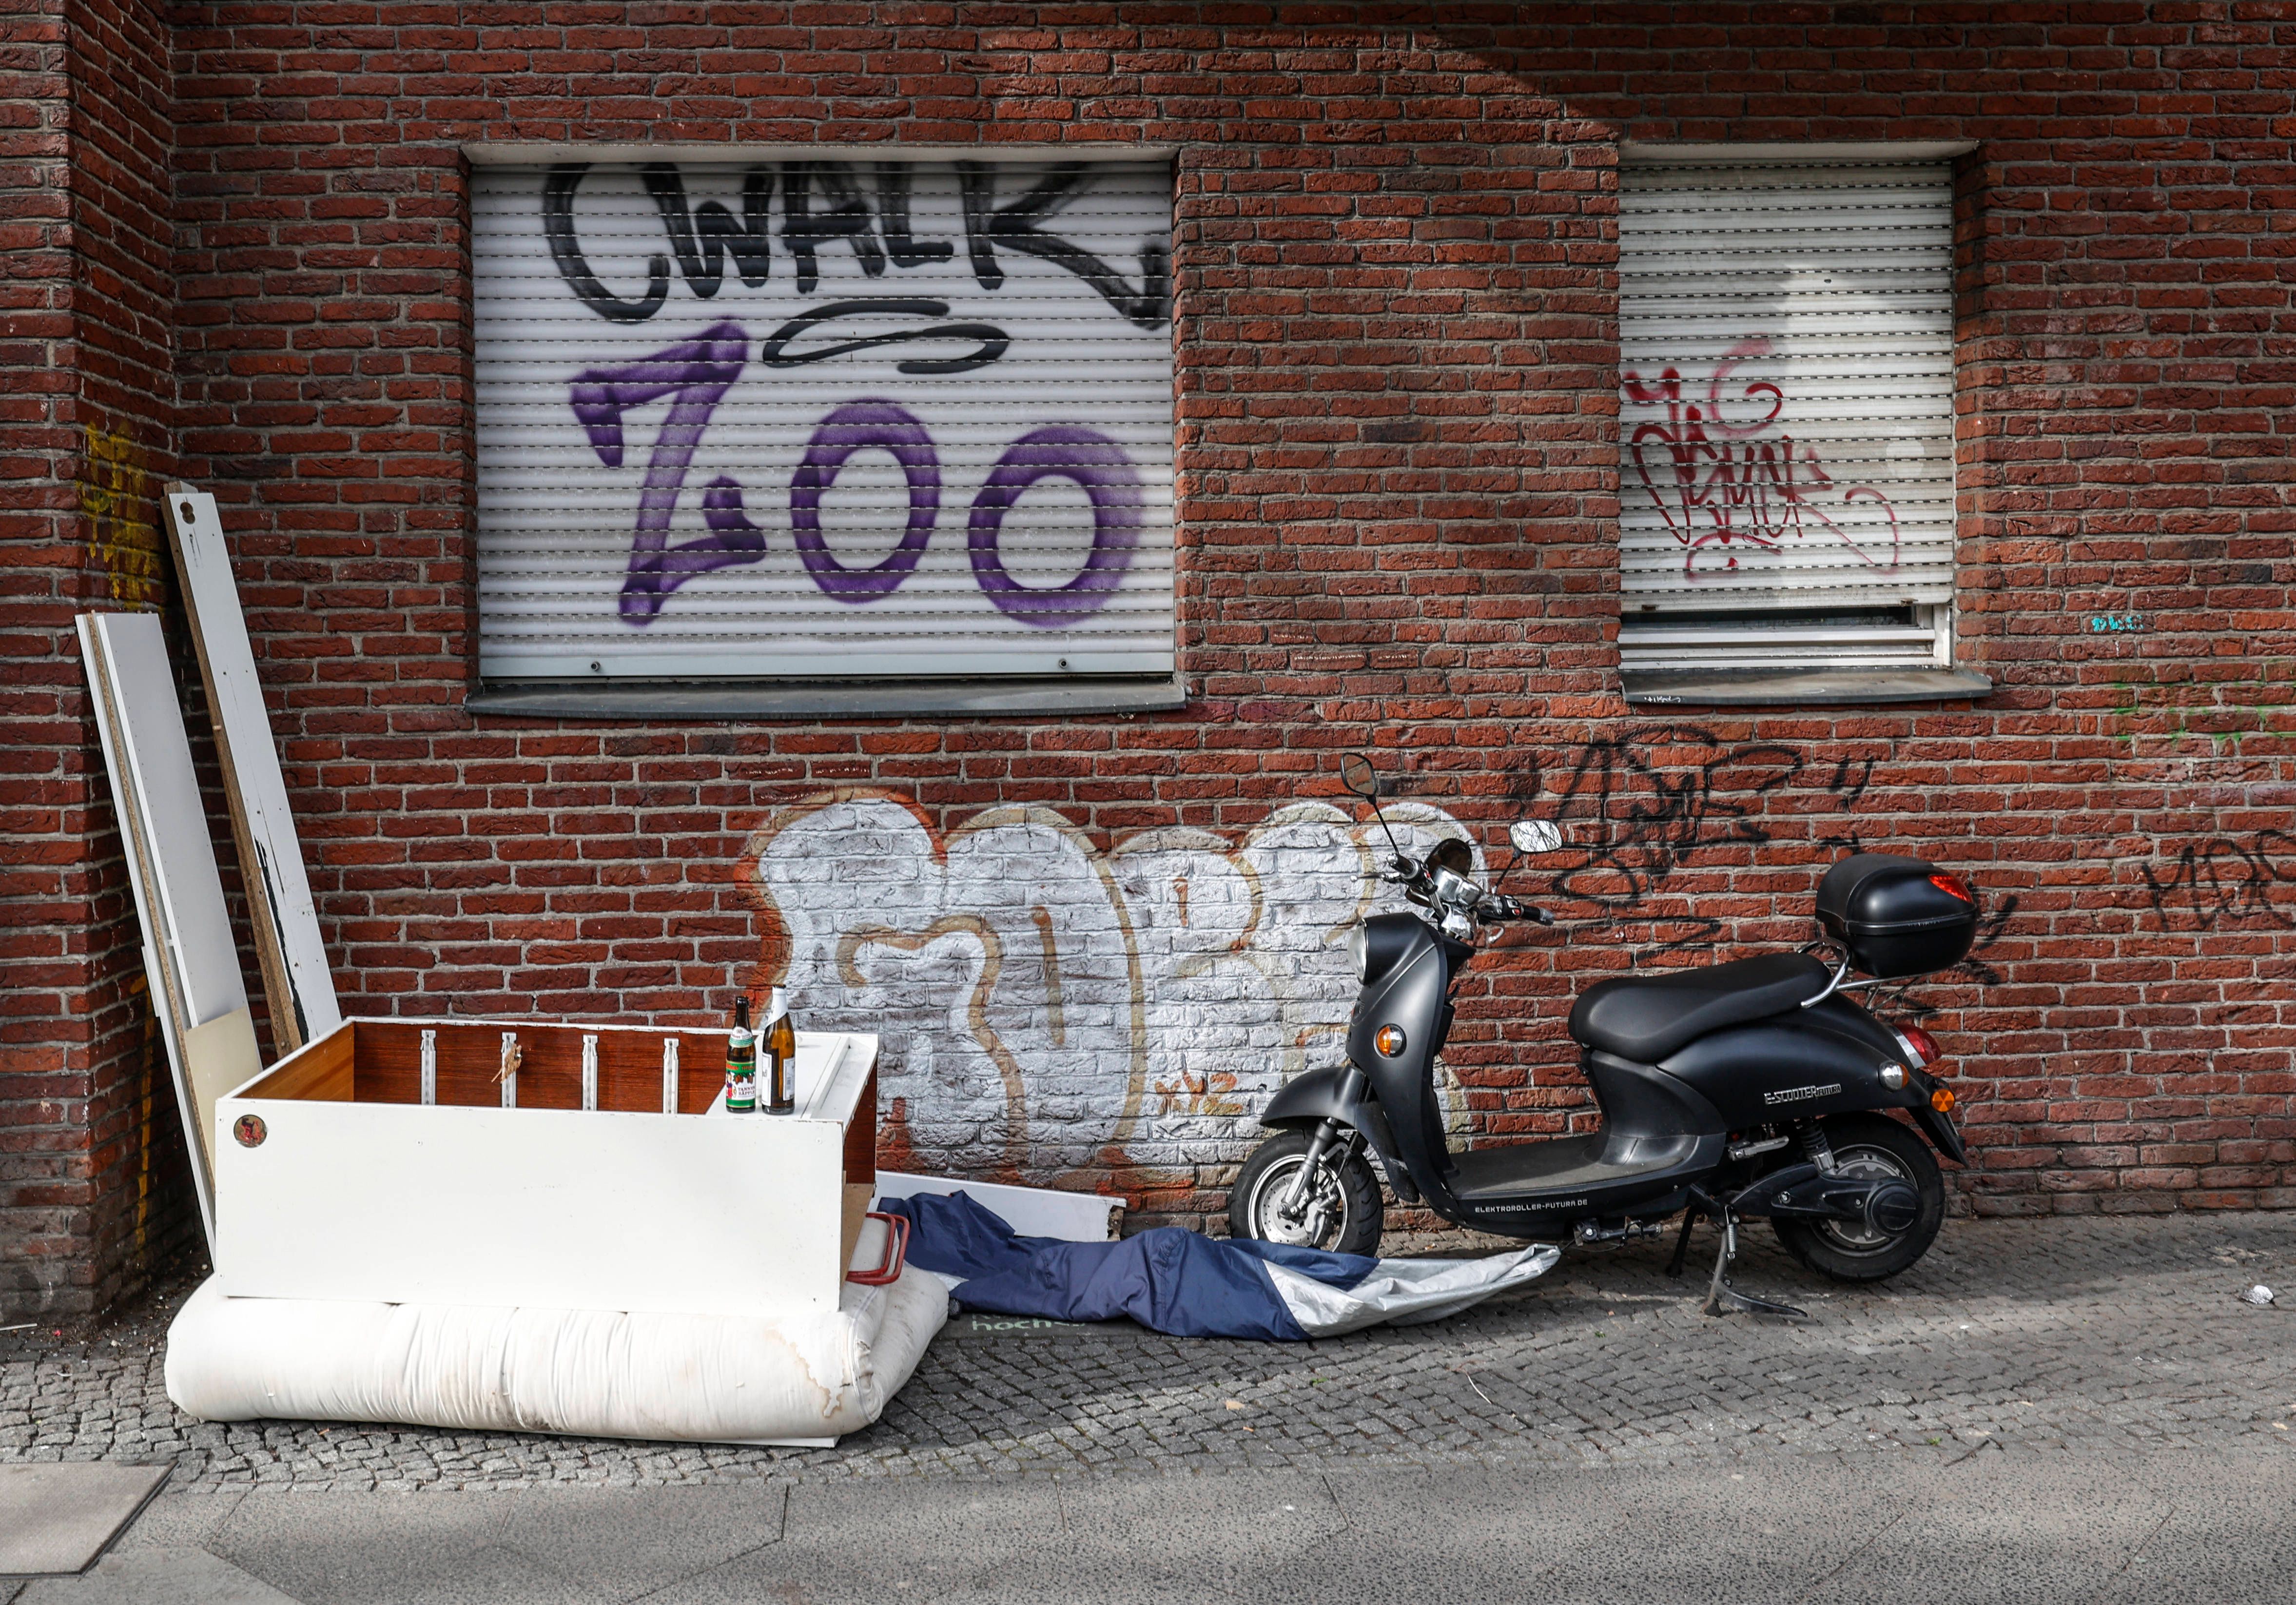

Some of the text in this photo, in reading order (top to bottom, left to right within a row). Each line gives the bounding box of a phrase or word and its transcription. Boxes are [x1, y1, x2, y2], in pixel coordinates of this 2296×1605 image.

[569, 315, 1145, 629] ZOO
[1764, 1085, 1817, 1105] E-SCOOTER
[1475, 1198, 1588, 1214] ELEKTROROLLER-FUTURA.DE
